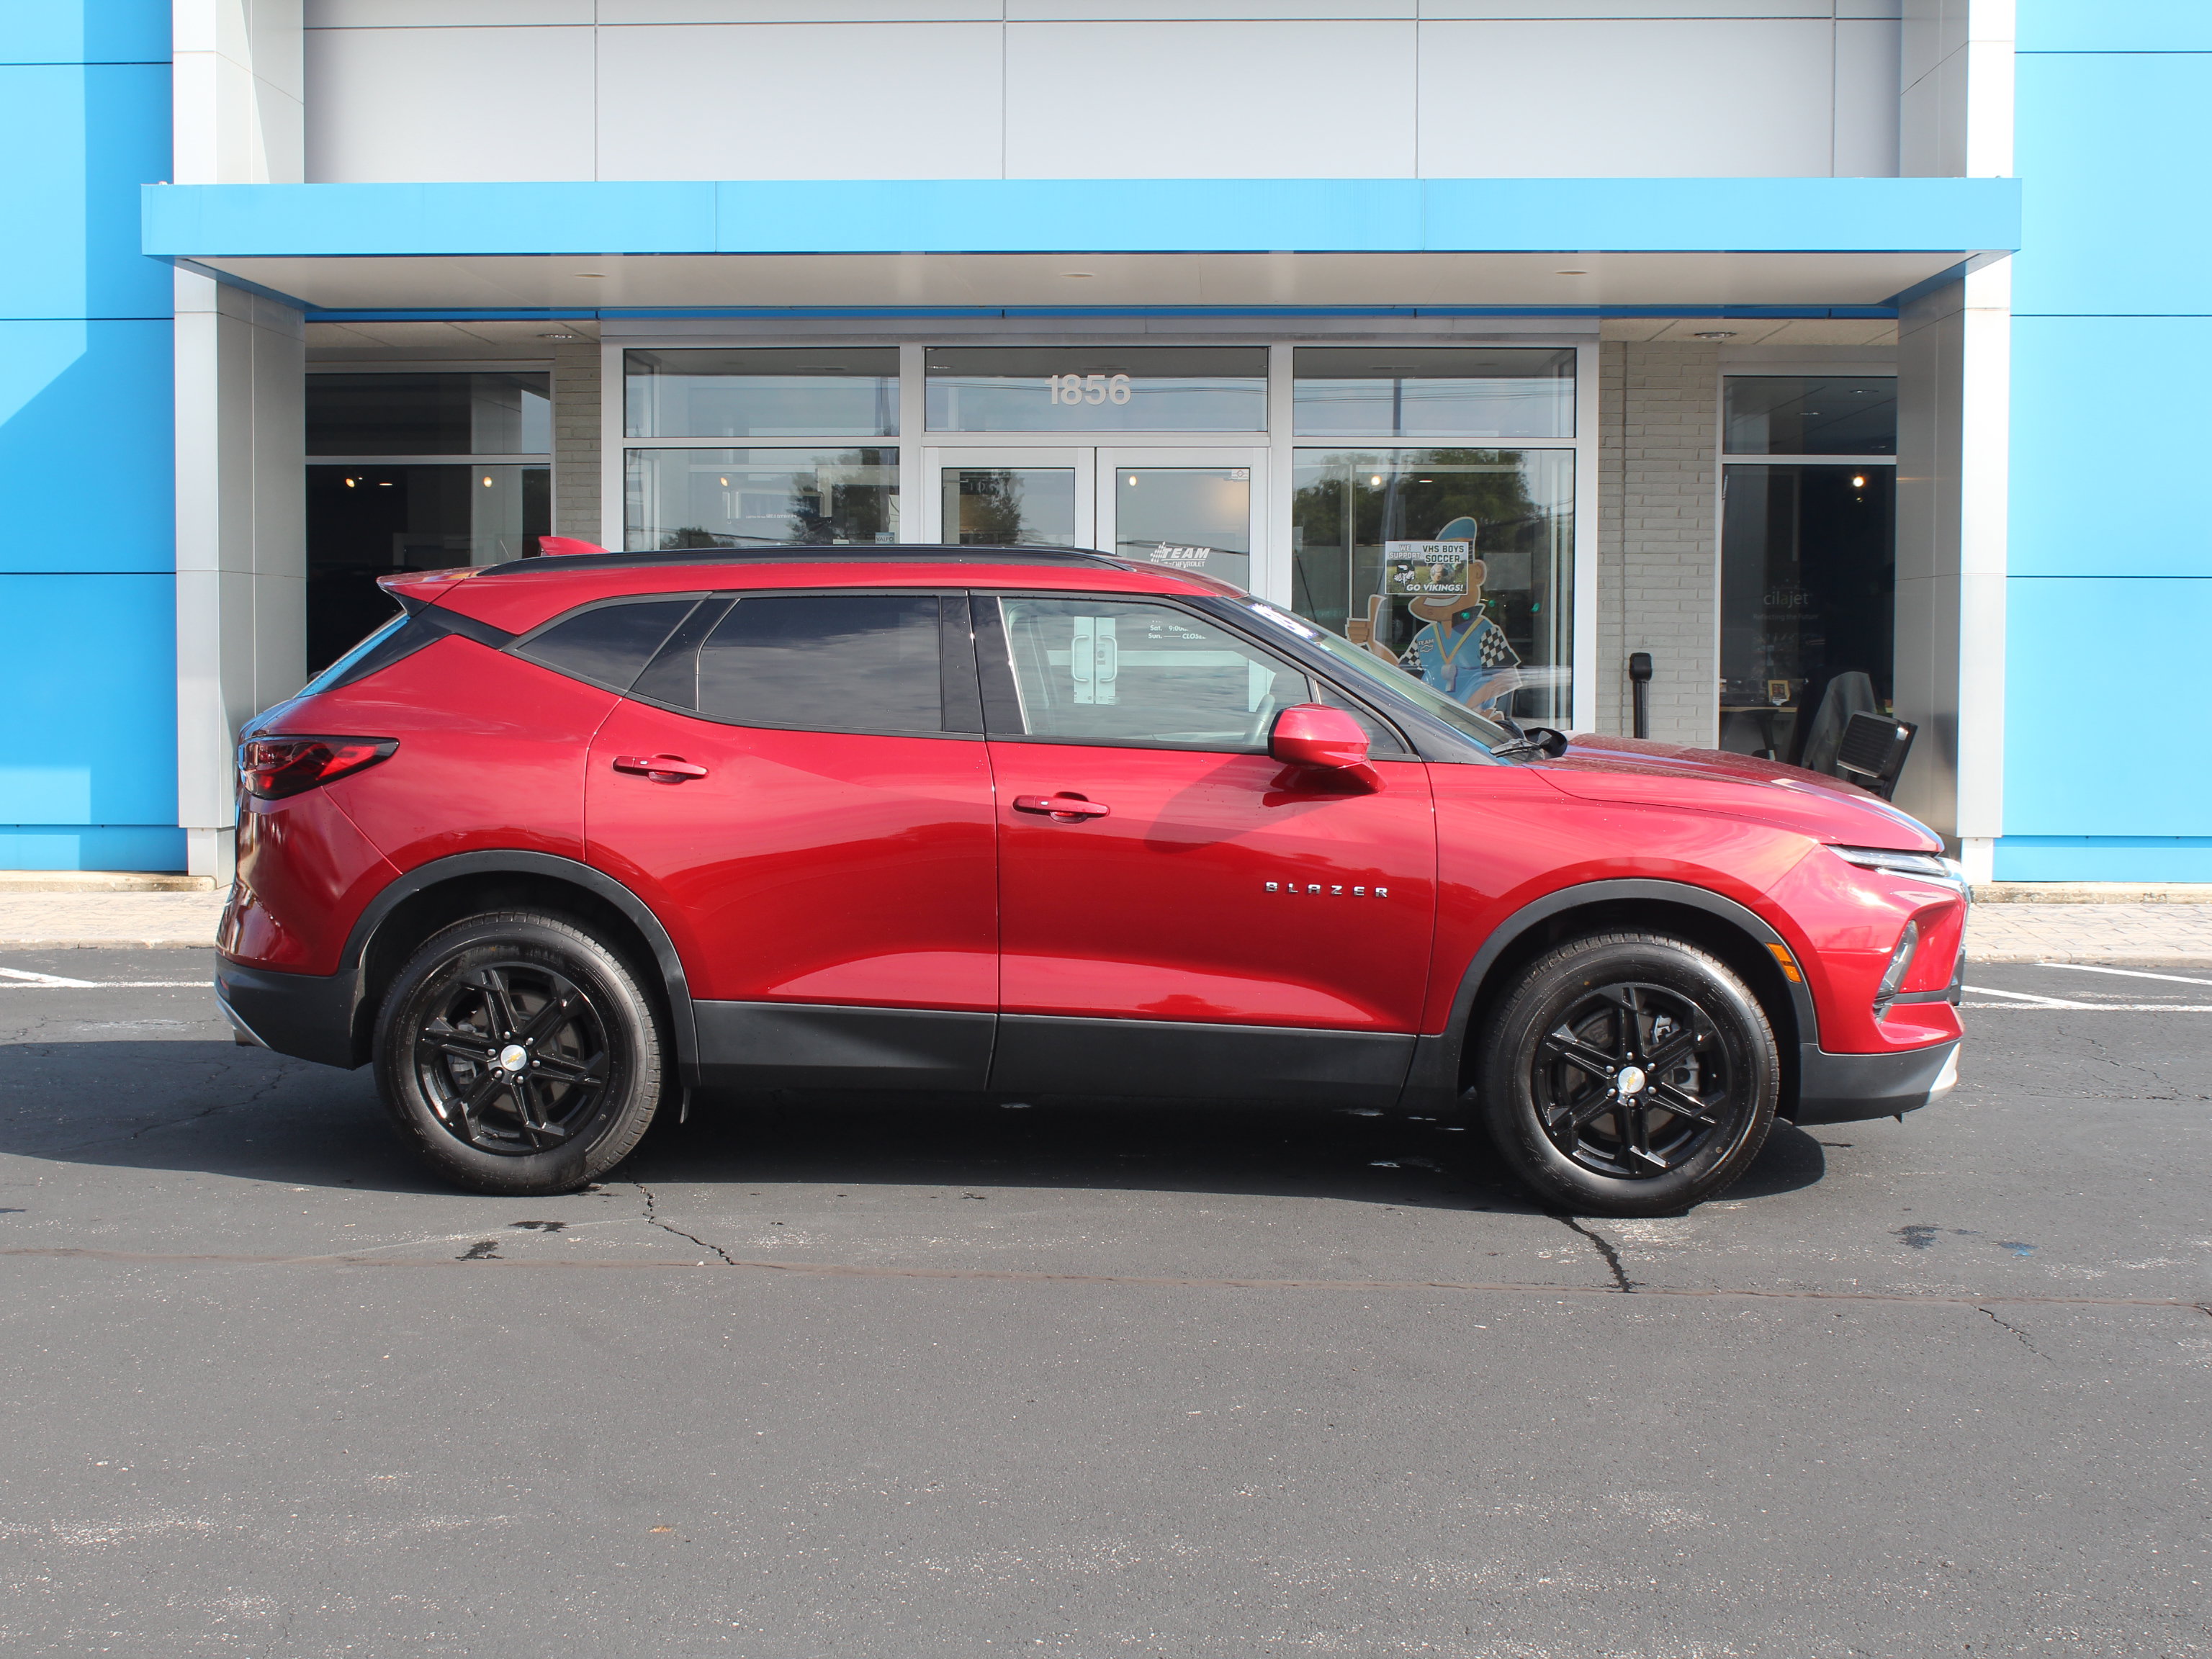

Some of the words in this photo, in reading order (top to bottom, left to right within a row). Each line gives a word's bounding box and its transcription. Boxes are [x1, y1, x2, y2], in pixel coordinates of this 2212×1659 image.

[1045, 374, 1131, 405] 1856
[1161, 547, 1210, 559] TEAM
[1763, 591, 1809, 608] cilajet
[1265, 881, 1388, 899] BLAZER
